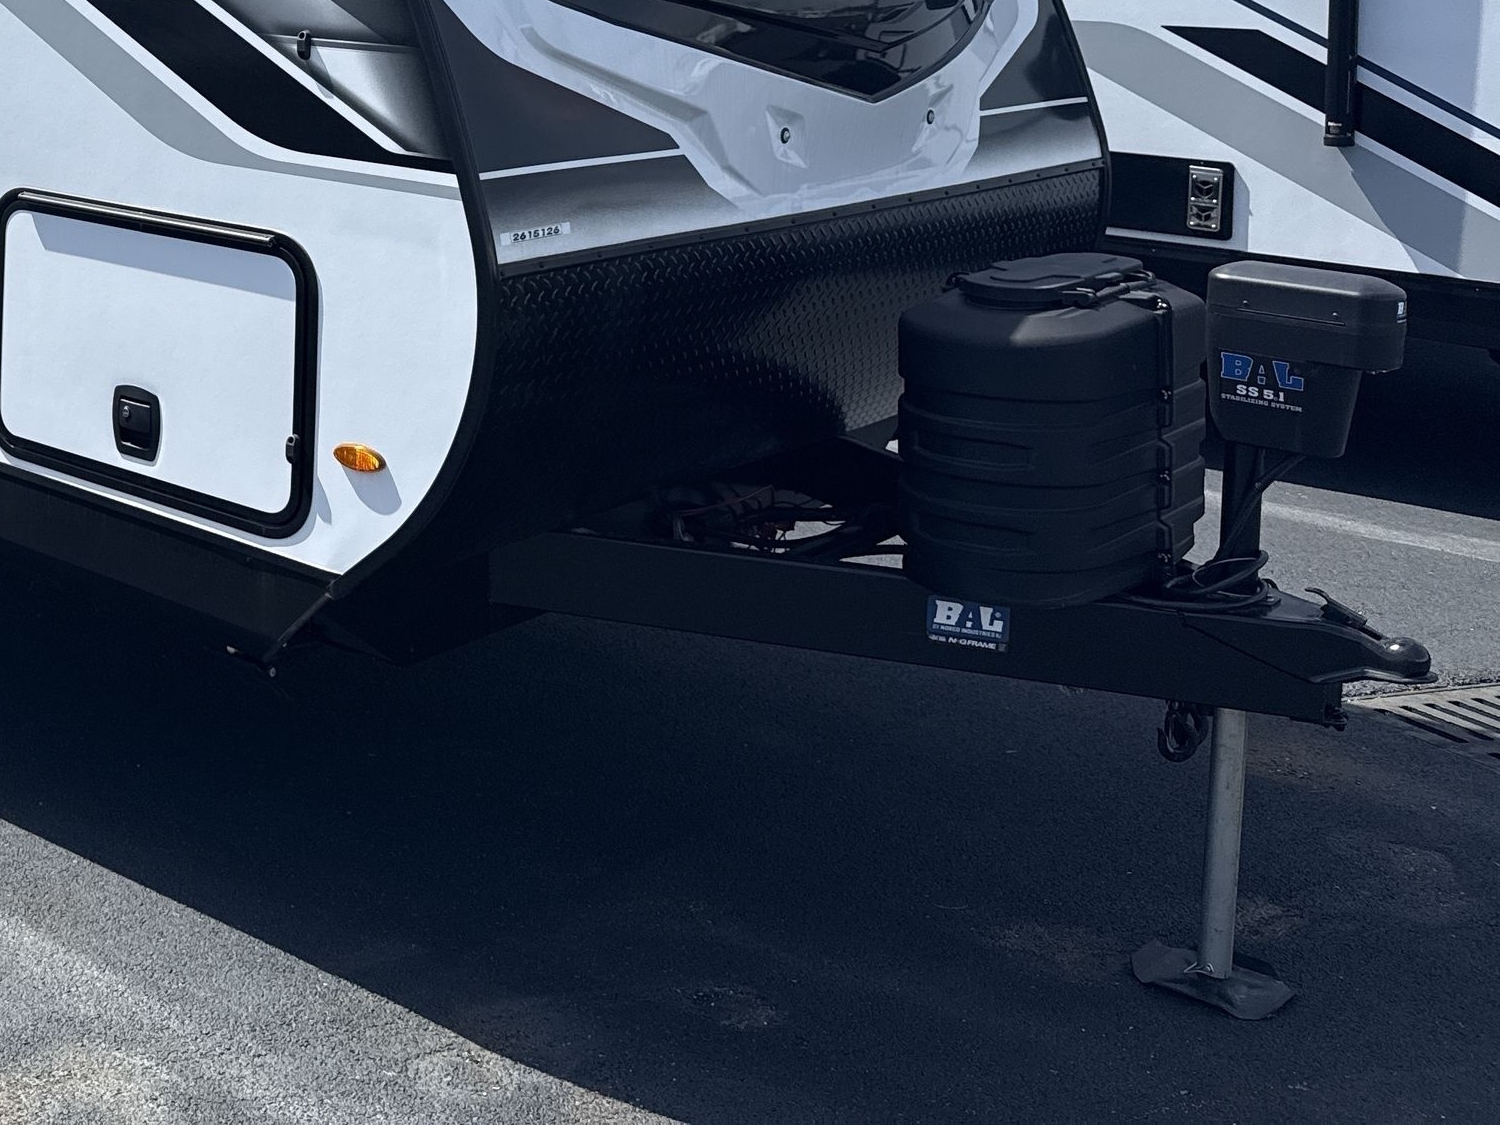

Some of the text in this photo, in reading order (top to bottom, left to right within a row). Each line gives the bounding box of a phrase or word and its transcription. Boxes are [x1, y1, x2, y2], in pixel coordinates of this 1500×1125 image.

[512, 225, 561, 241] 2615126
[1221, 351, 1304, 391] BAL
[1236, 384, 1284, 402] SS 5.1
[933, 599, 1004, 633] BAL
